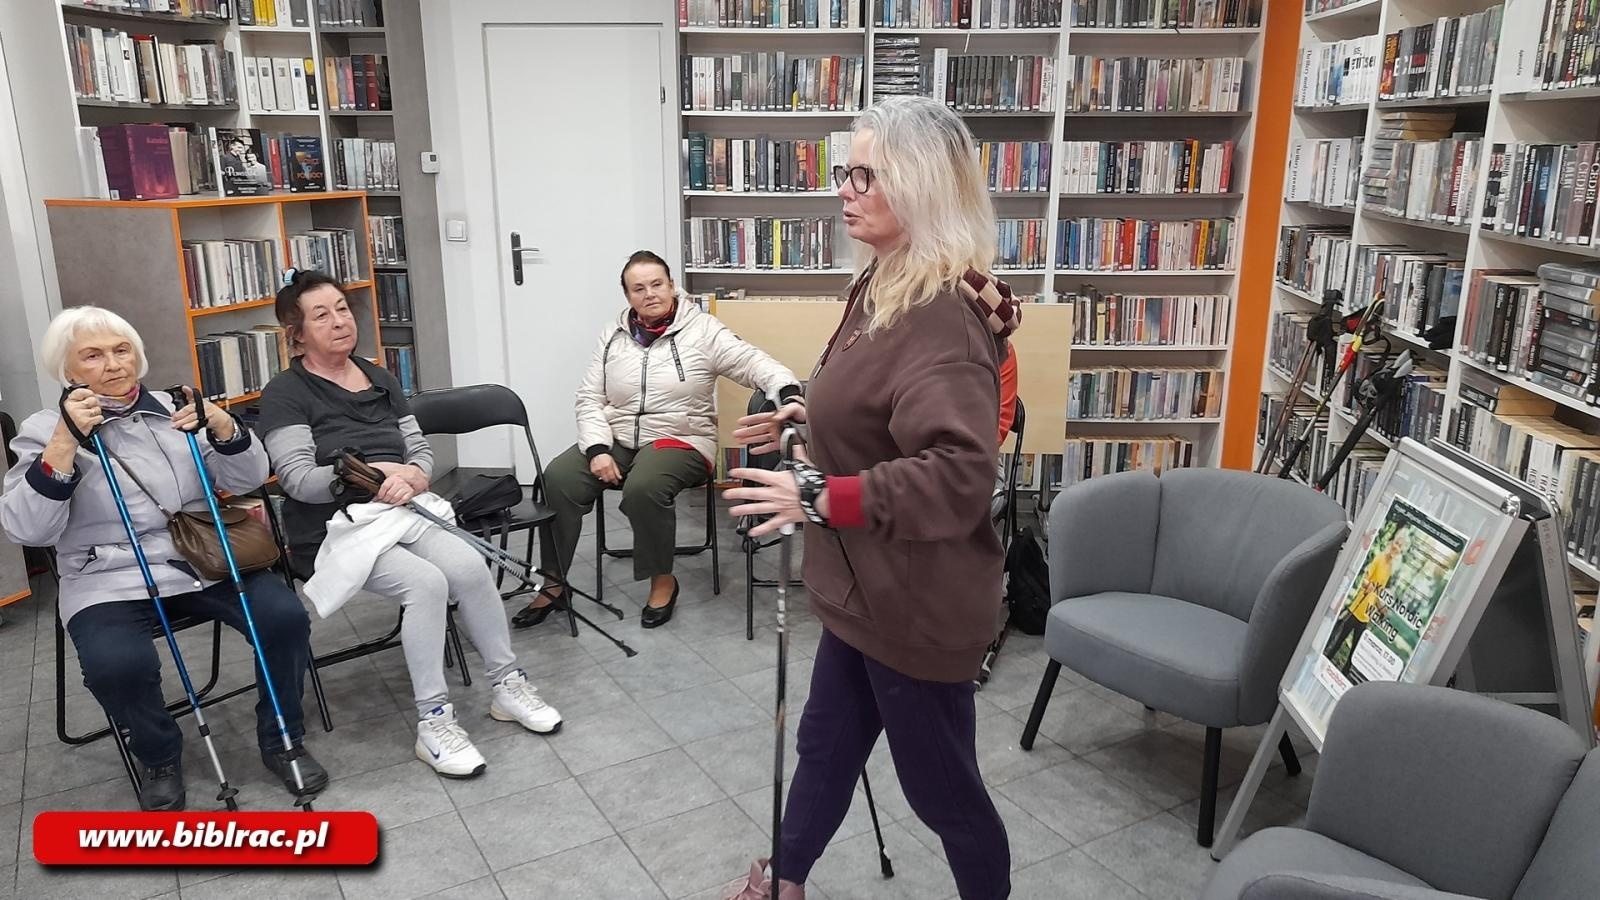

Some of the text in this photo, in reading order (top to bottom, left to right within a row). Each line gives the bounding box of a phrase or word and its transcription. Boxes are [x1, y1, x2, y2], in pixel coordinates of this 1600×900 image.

[1573, 161, 1590, 202] CEDER
[1585, 162, 1600, 204] CEDER
[1373, 582, 1422, 628] Kurs Nordic
